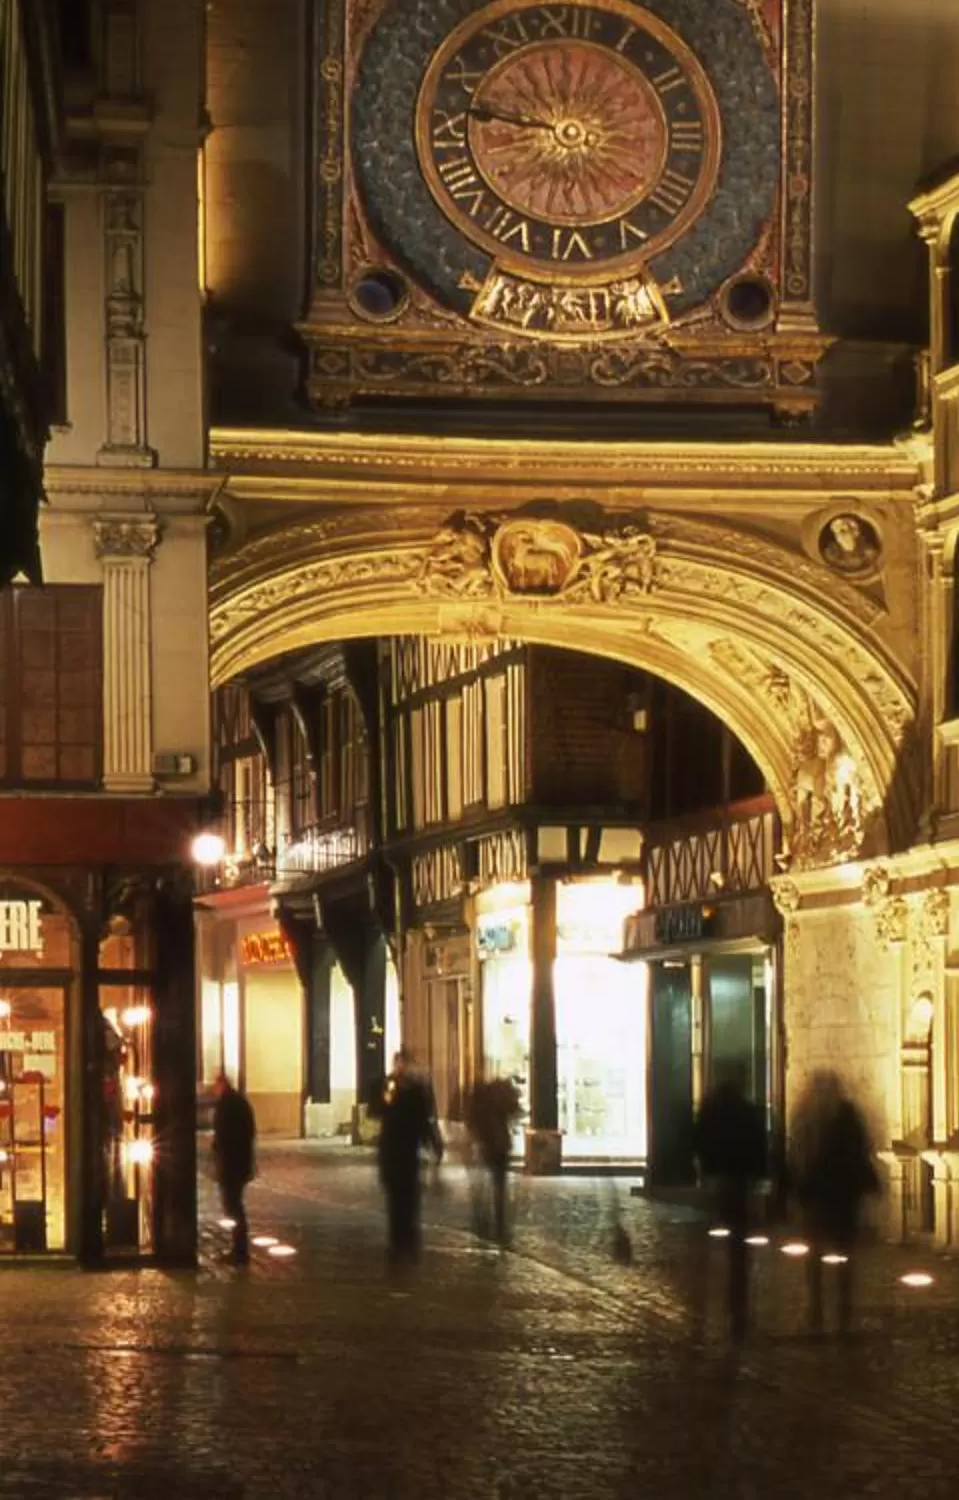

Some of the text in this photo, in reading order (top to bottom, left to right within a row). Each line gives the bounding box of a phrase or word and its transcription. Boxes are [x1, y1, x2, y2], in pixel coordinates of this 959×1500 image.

[540, 8, 591, 37] XII
[655, 68, 686, 94] II
[672, 121, 702, 151] III
[439, 161, 484, 217] VIII
[483, 206, 529, 252] VII
[619, 221, 649, 250] V
[551, 229, 592, 261] VI
